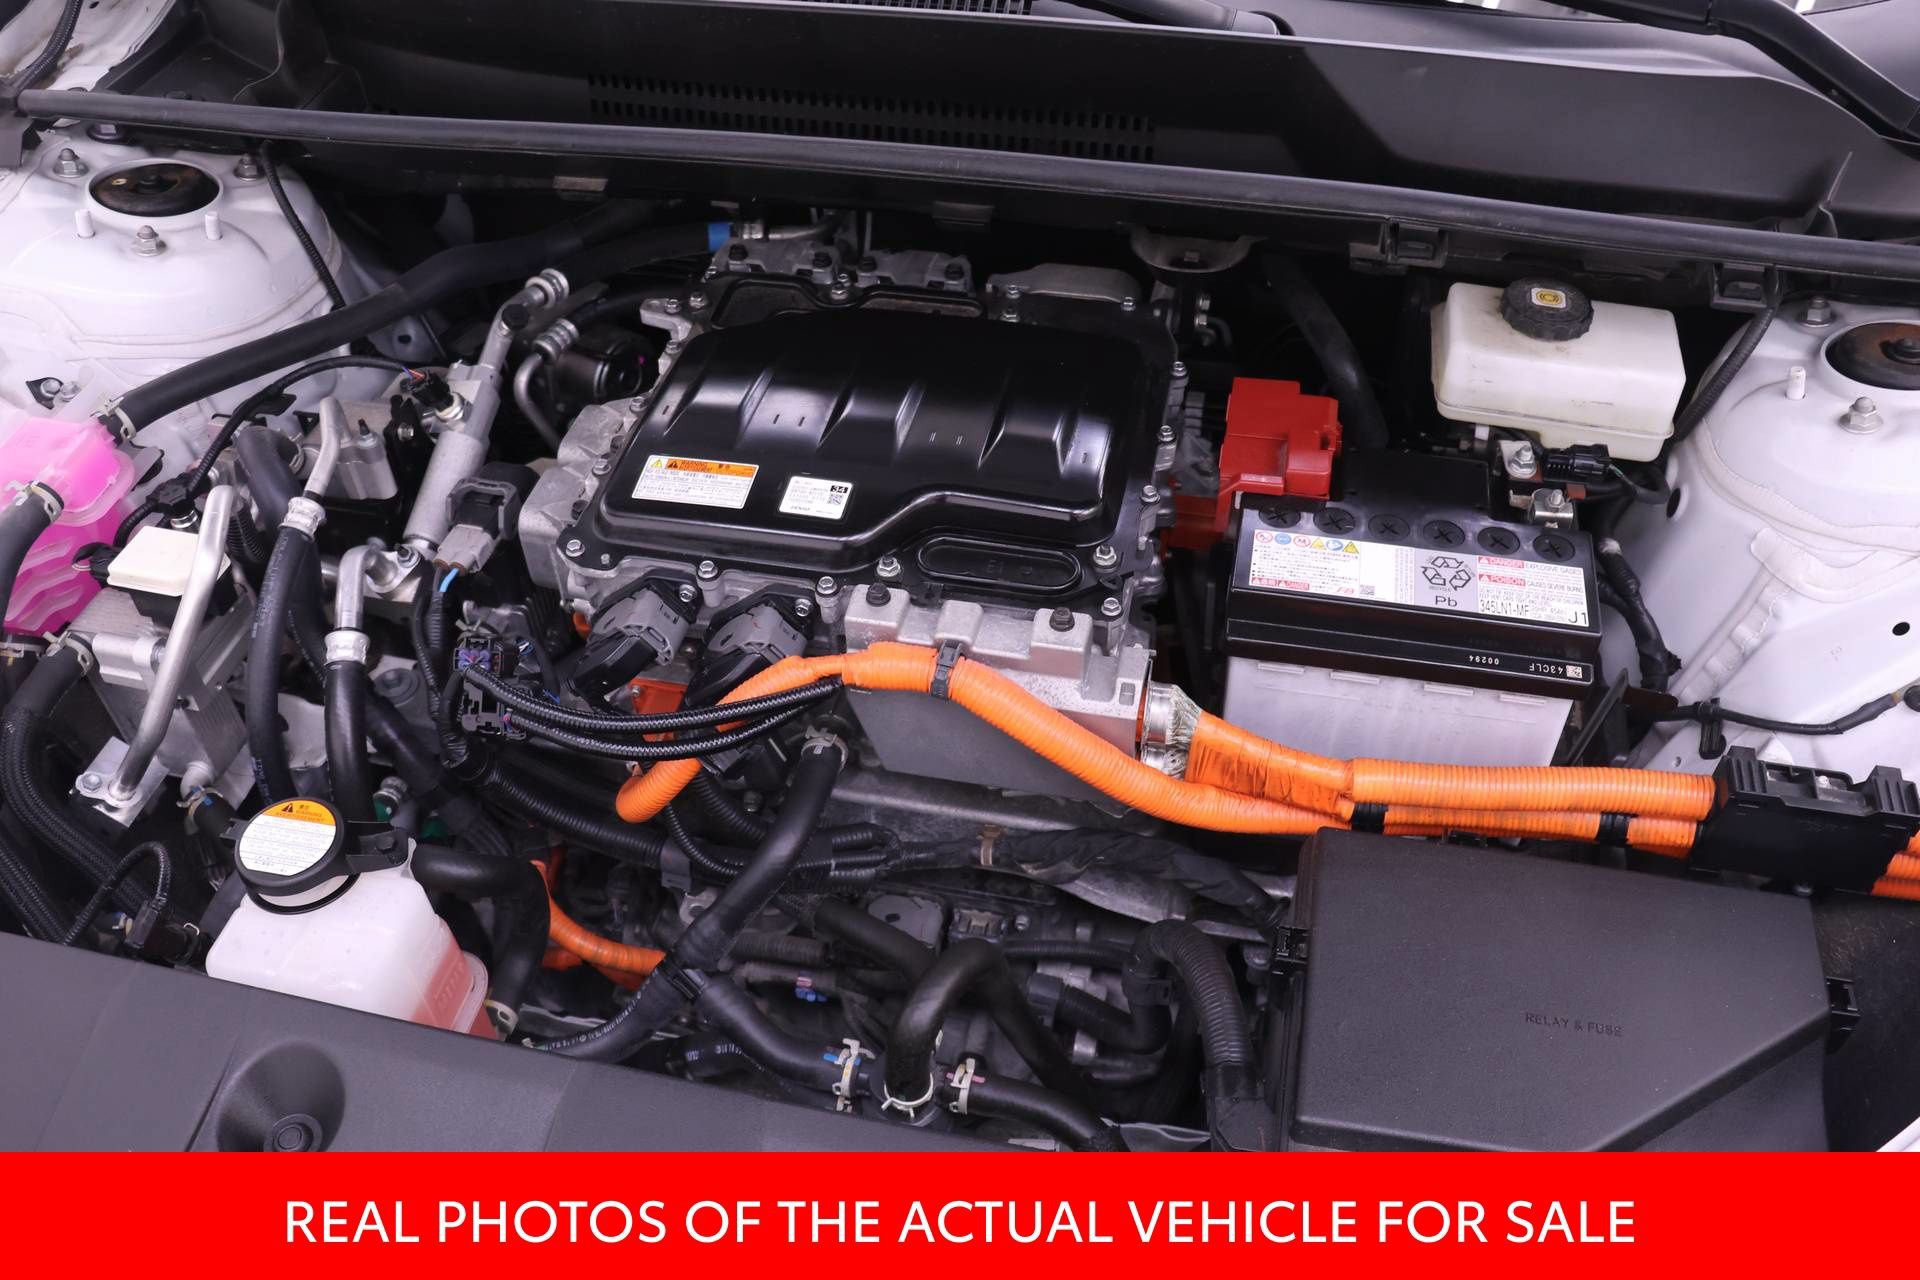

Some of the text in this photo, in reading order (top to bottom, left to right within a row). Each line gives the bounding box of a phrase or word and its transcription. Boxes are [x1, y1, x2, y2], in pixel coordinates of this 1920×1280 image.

[1490, 575, 1526, 586] POISON
[1435, 595, 1458, 607] Pb
[1480, 599, 1529, 617] 345LN1-MF
[1469, 655, 1564, 675] 43CLF 00294
[1525, 1012, 1625, 1037] RELAY & FUSE
